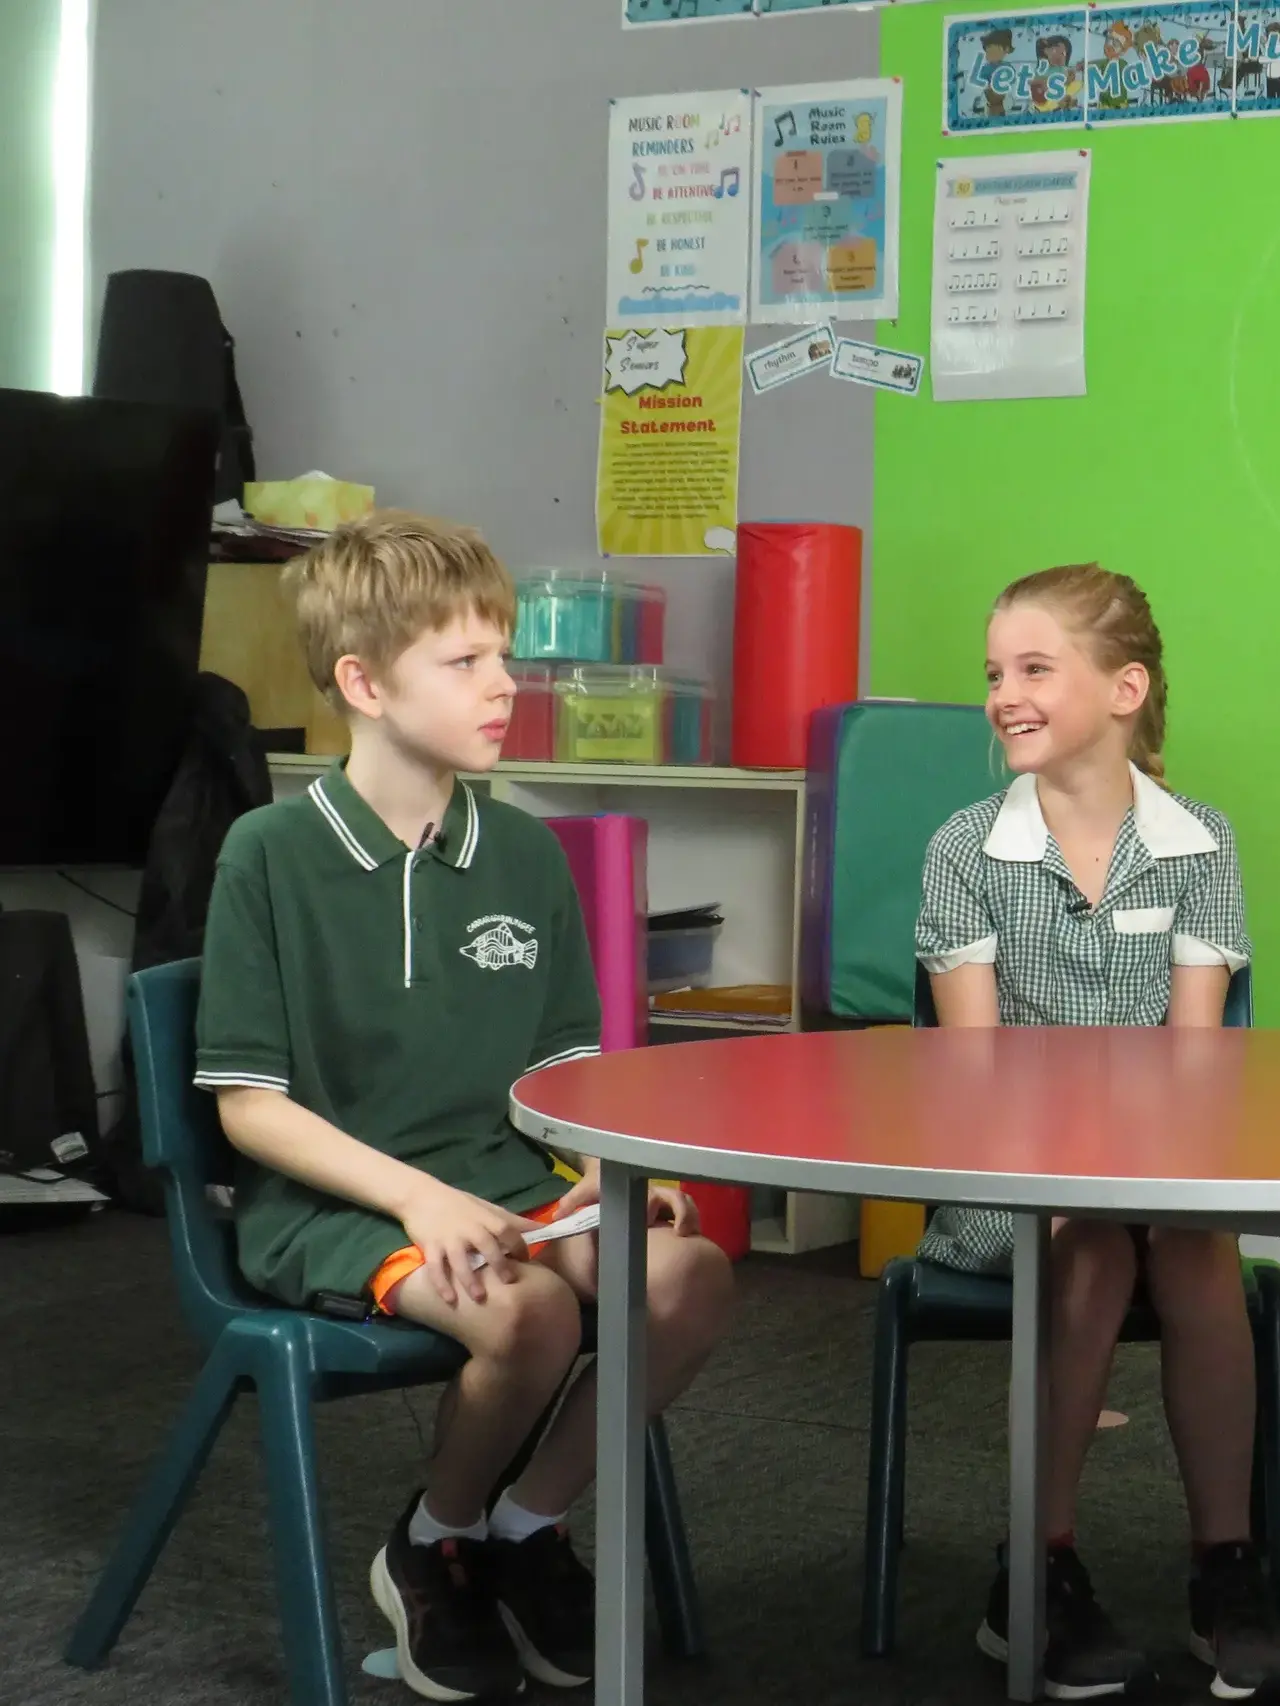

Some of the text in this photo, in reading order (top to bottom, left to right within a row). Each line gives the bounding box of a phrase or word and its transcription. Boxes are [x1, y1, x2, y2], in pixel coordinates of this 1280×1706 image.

[968, 53, 1067, 101] Let's
[1087, 35, 1201, 99] Make
[809, 106, 846, 119] Music
[628, 116, 661, 132] MUSIC
[810, 120, 846, 132] Room
[809, 133, 846, 145] Rules
[632, 138, 694, 157] REMINDERS
[667, 184, 714, 200] ATTENTIVE
[671, 236, 705, 251] HONEST
[626, 336, 660, 354] Super
[620, 357, 660, 373] Seniors
[760, 350, 797, 370] rhythm
[638, 394, 703, 410] Mission
[620, 418, 717, 435] Statement
